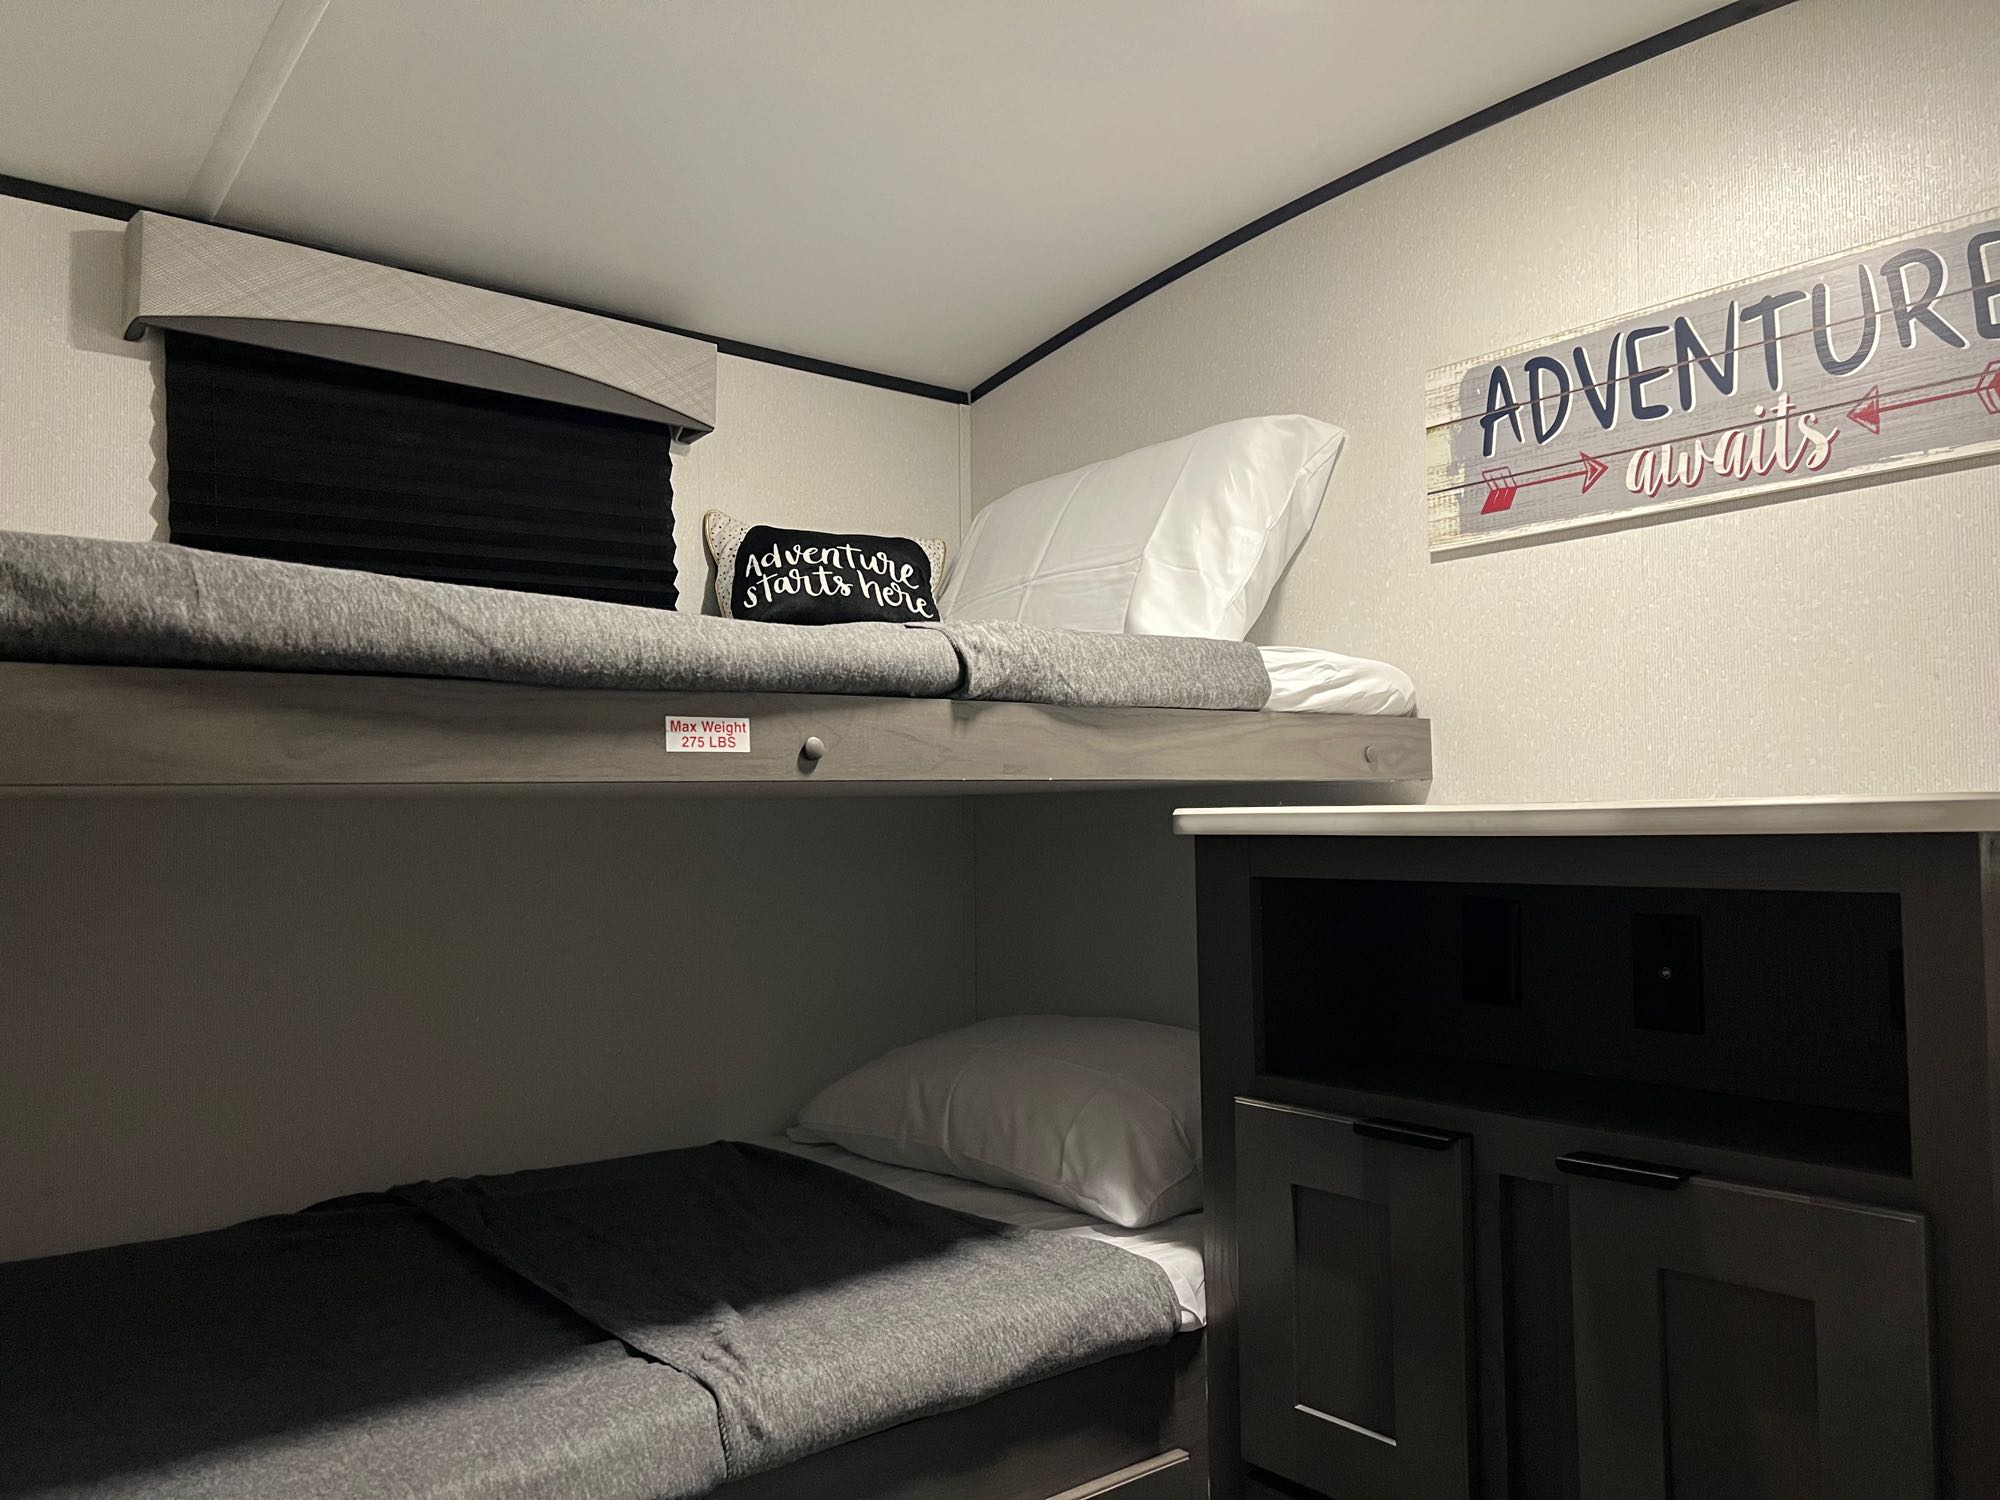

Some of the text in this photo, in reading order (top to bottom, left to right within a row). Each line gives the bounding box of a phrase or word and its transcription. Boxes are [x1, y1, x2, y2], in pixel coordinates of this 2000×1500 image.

[1479, 230, 2000, 459] ADVENTURE
[1625, 393, 1839, 496] awaits
[743, 565, 934, 618] starts here
[745, 543, 919, 590] Adventure
[670, 720, 747, 736] Max Weight
[682, 736, 736, 748] 275 LBS
